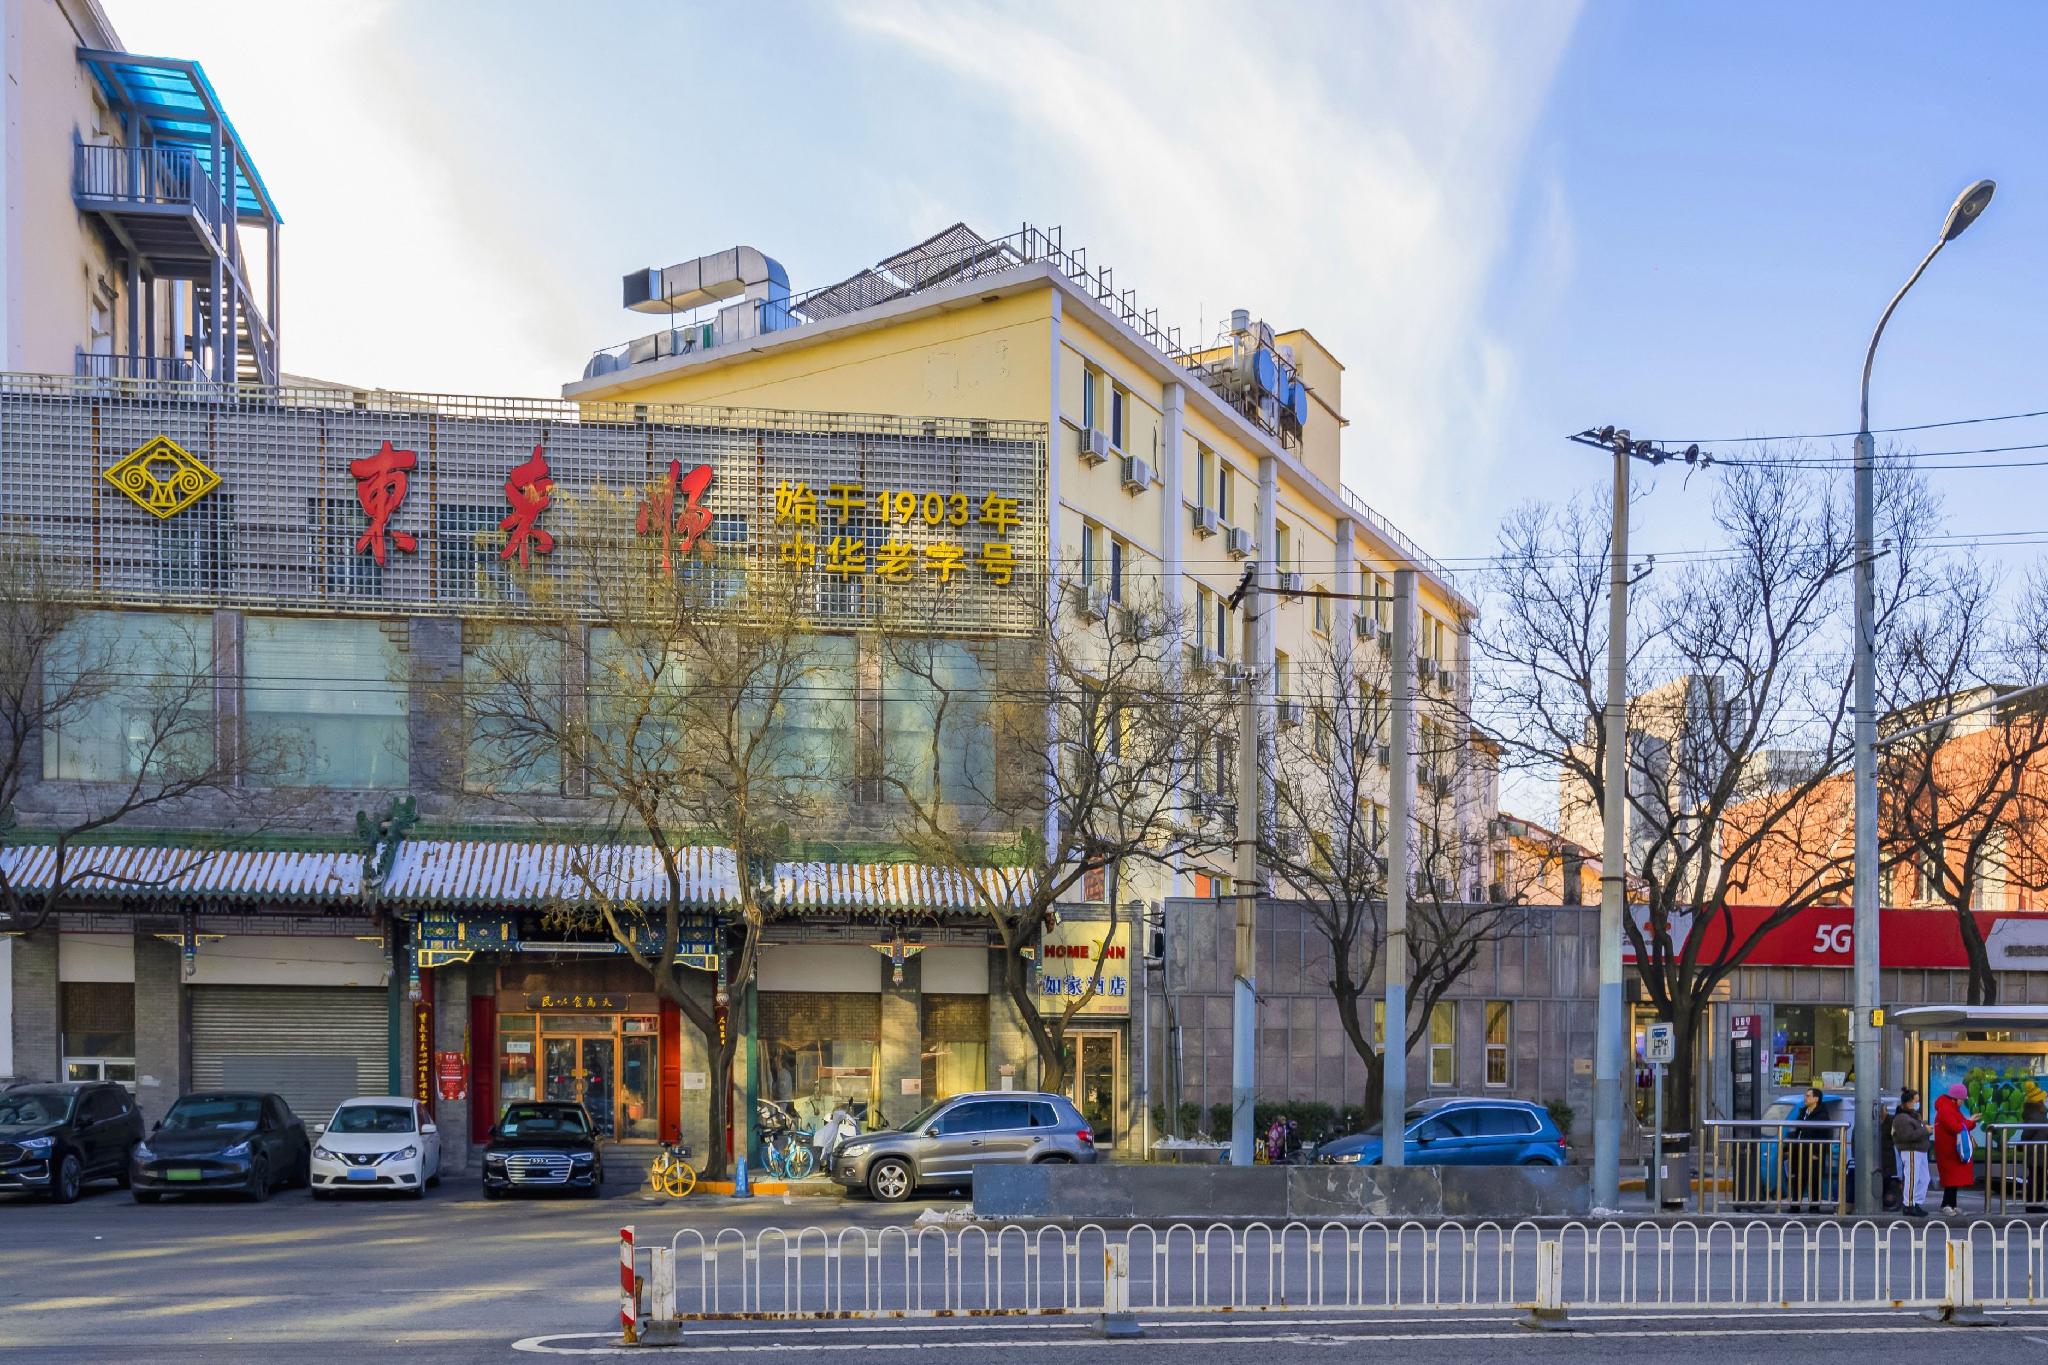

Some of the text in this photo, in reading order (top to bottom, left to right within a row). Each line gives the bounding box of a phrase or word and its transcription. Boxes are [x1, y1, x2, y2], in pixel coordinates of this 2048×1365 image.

[774, 480, 1021, 535] 始于1903年
[780, 532, 1018, 585] 中华老字号
[1044, 945, 1089, 958] HOME
